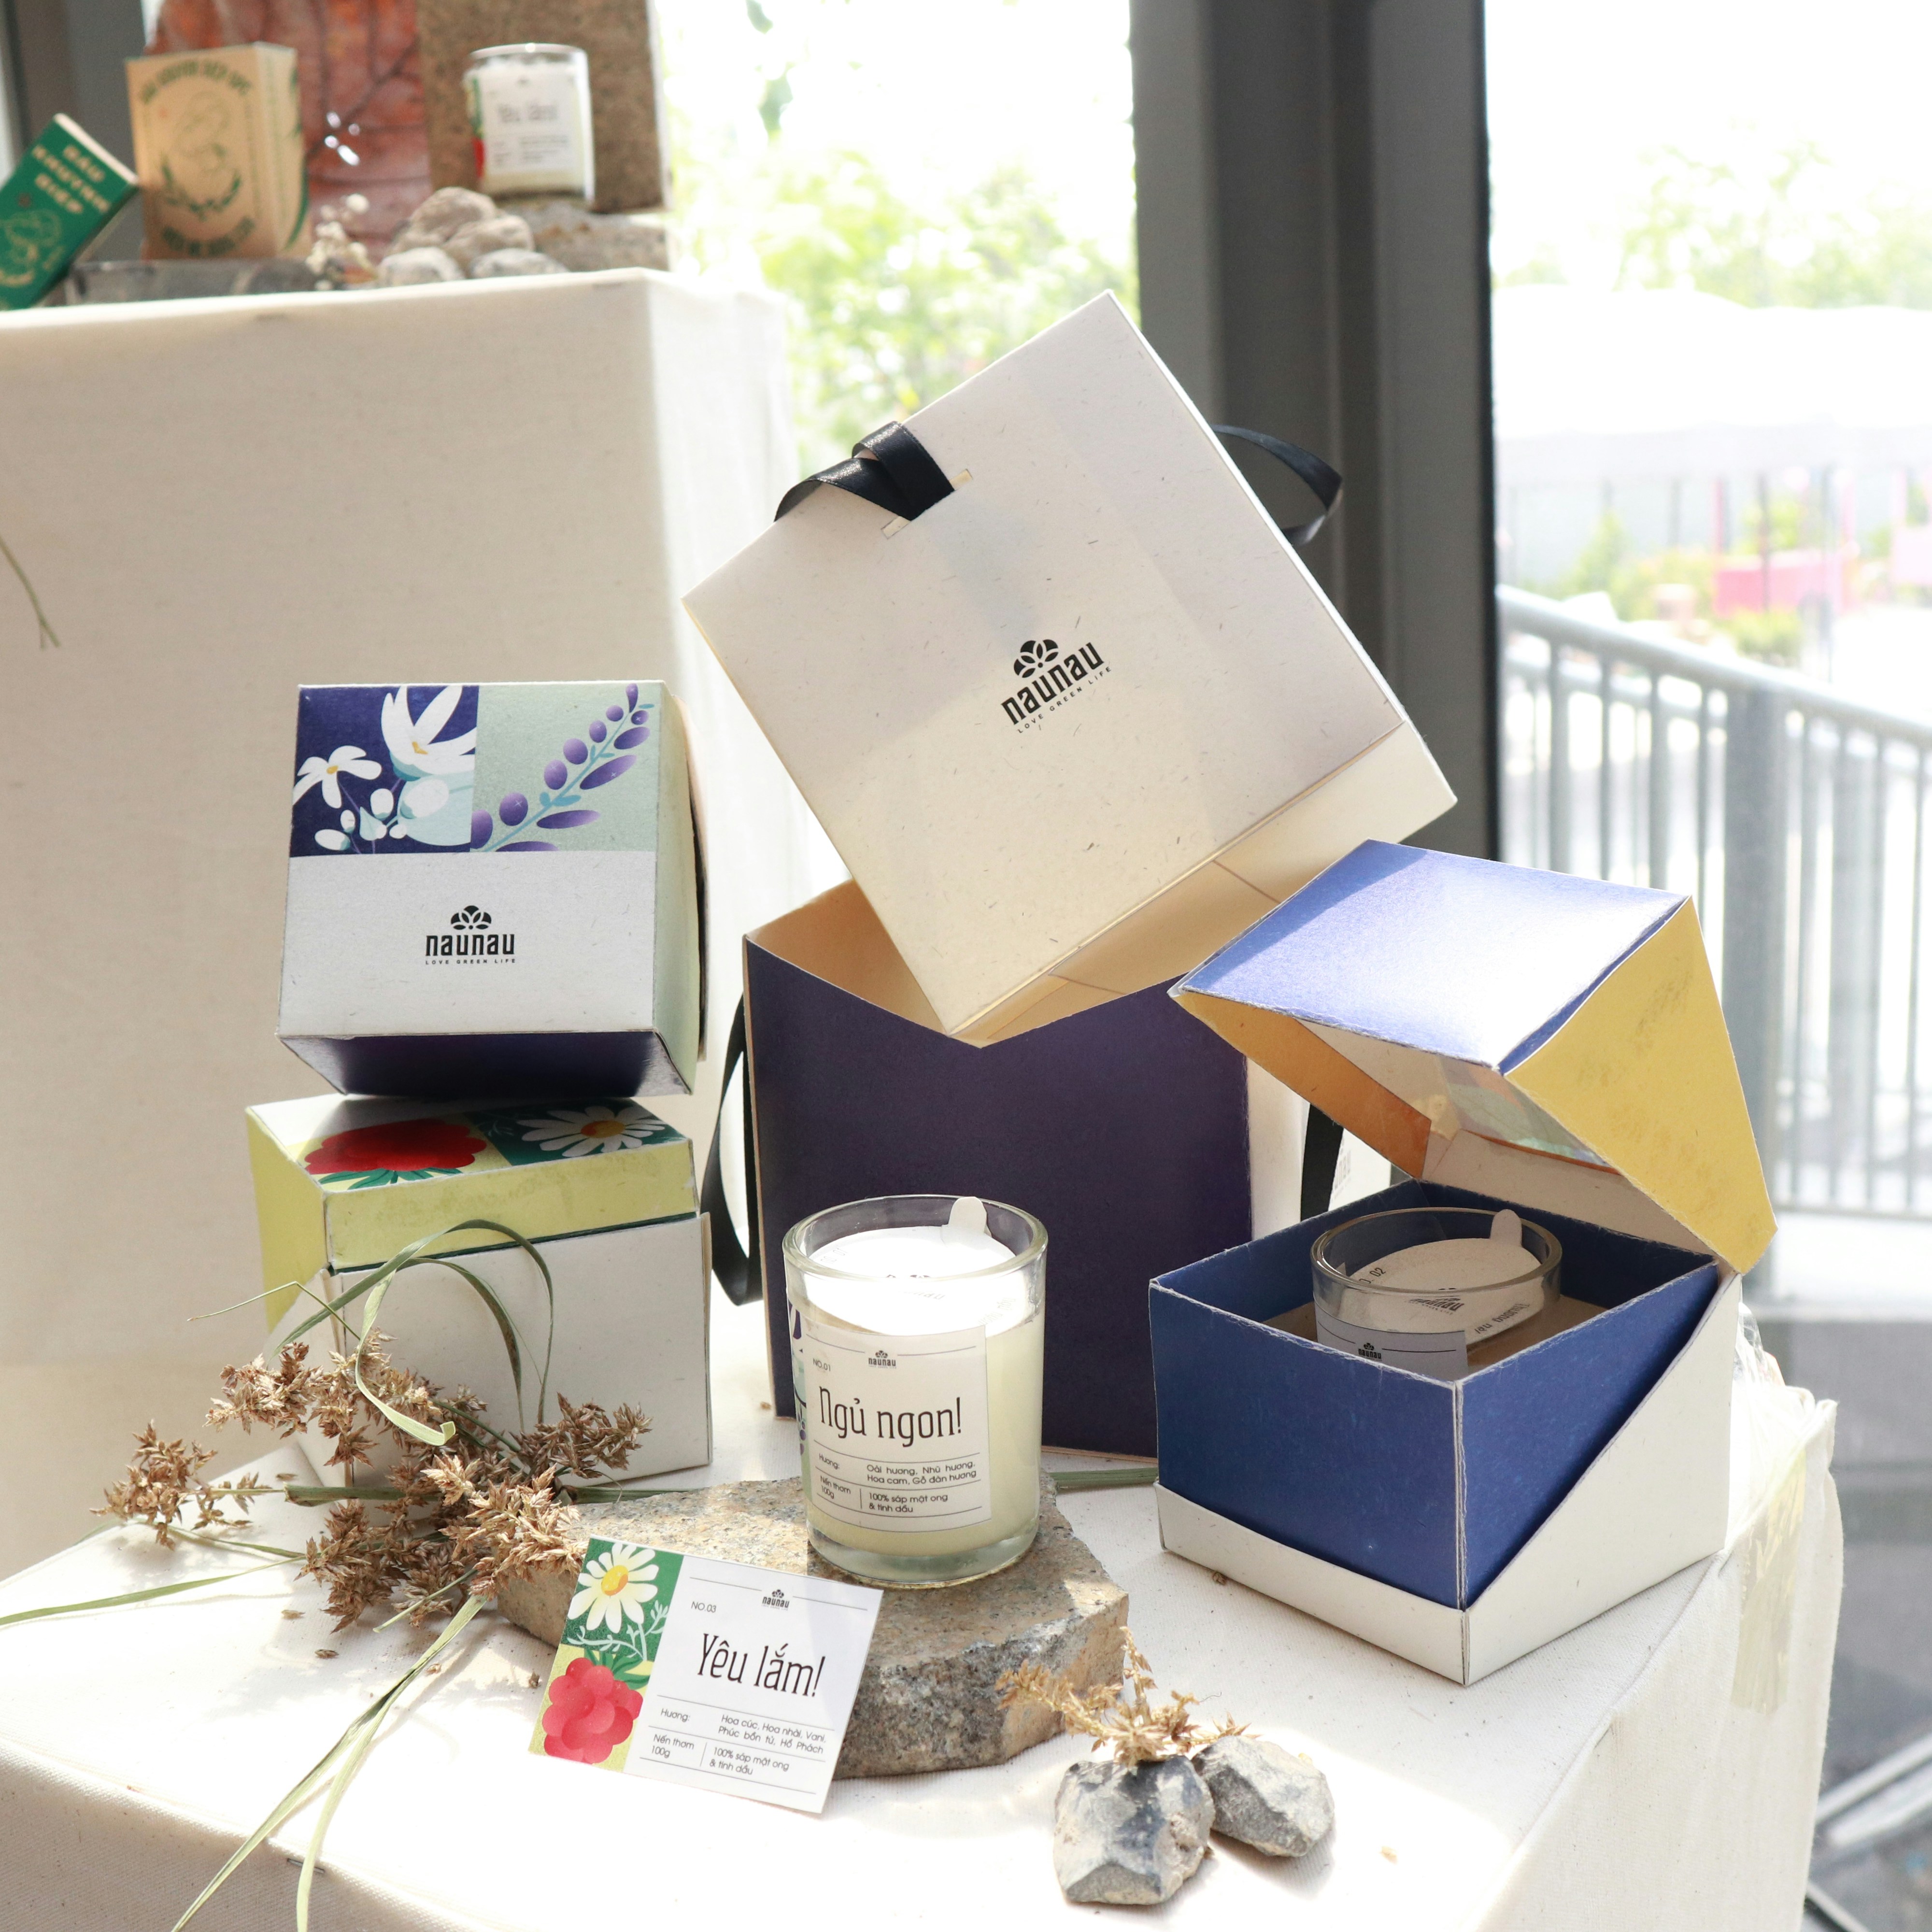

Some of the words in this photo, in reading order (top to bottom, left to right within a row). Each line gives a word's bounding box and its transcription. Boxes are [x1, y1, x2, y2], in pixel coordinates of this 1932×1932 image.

[1001, 642, 1104, 725] naunau
[1017, 714, 1043, 733] LOVE
[1050, 686, 1082, 711] GREEN
[1088, 667, 1111, 685] LIFE
[426, 934, 514, 956] naunau
[1369, 1267, 1387, 1277] 02
[1358, 1348, 1381, 1359] naunau
[812, 1358, 831, 1372] NO.01
[868, 1358, 896, 1366] naunau
[819, 1386, 867, 1438] Ngủ
[877, 1396, 962, 1448] ngon!
[867, 1475, 885, 1484] Hoa
[821, 1485, 835, 1499] 100g
[869, 1492, 889, 1502] 100%
[891, 1495, 908, 1504] sáp
[930, 1494, 948, 1502] ong
[877, 1504, 893, 1512] tinh
[691, 1601, 717, 1613] NO.03
[762, 1596, 790, 1608] naunau
[697, 1633, 748, 1684] Yêu
[753, 1643, 826, 1697] lắm!
[721, 1714, 739, 1726] Hoa
[741, 1719, 760, 1730] cúc,
[762, 1723, 781, 1734] Hoa
[718, 1726, 740, 1738] Phúc
[796, 1741, 824, 1754] Phách
[652, 1745, 670, 1759] 100g
[709, 1759, 716, 1768] &
[718, 1760, 734, 1771] tinh
[714, 1747, 734, 1759] 100%
[735, 1752, 751, 1763] sáp
[772, 1761, 790, 1772] ong
